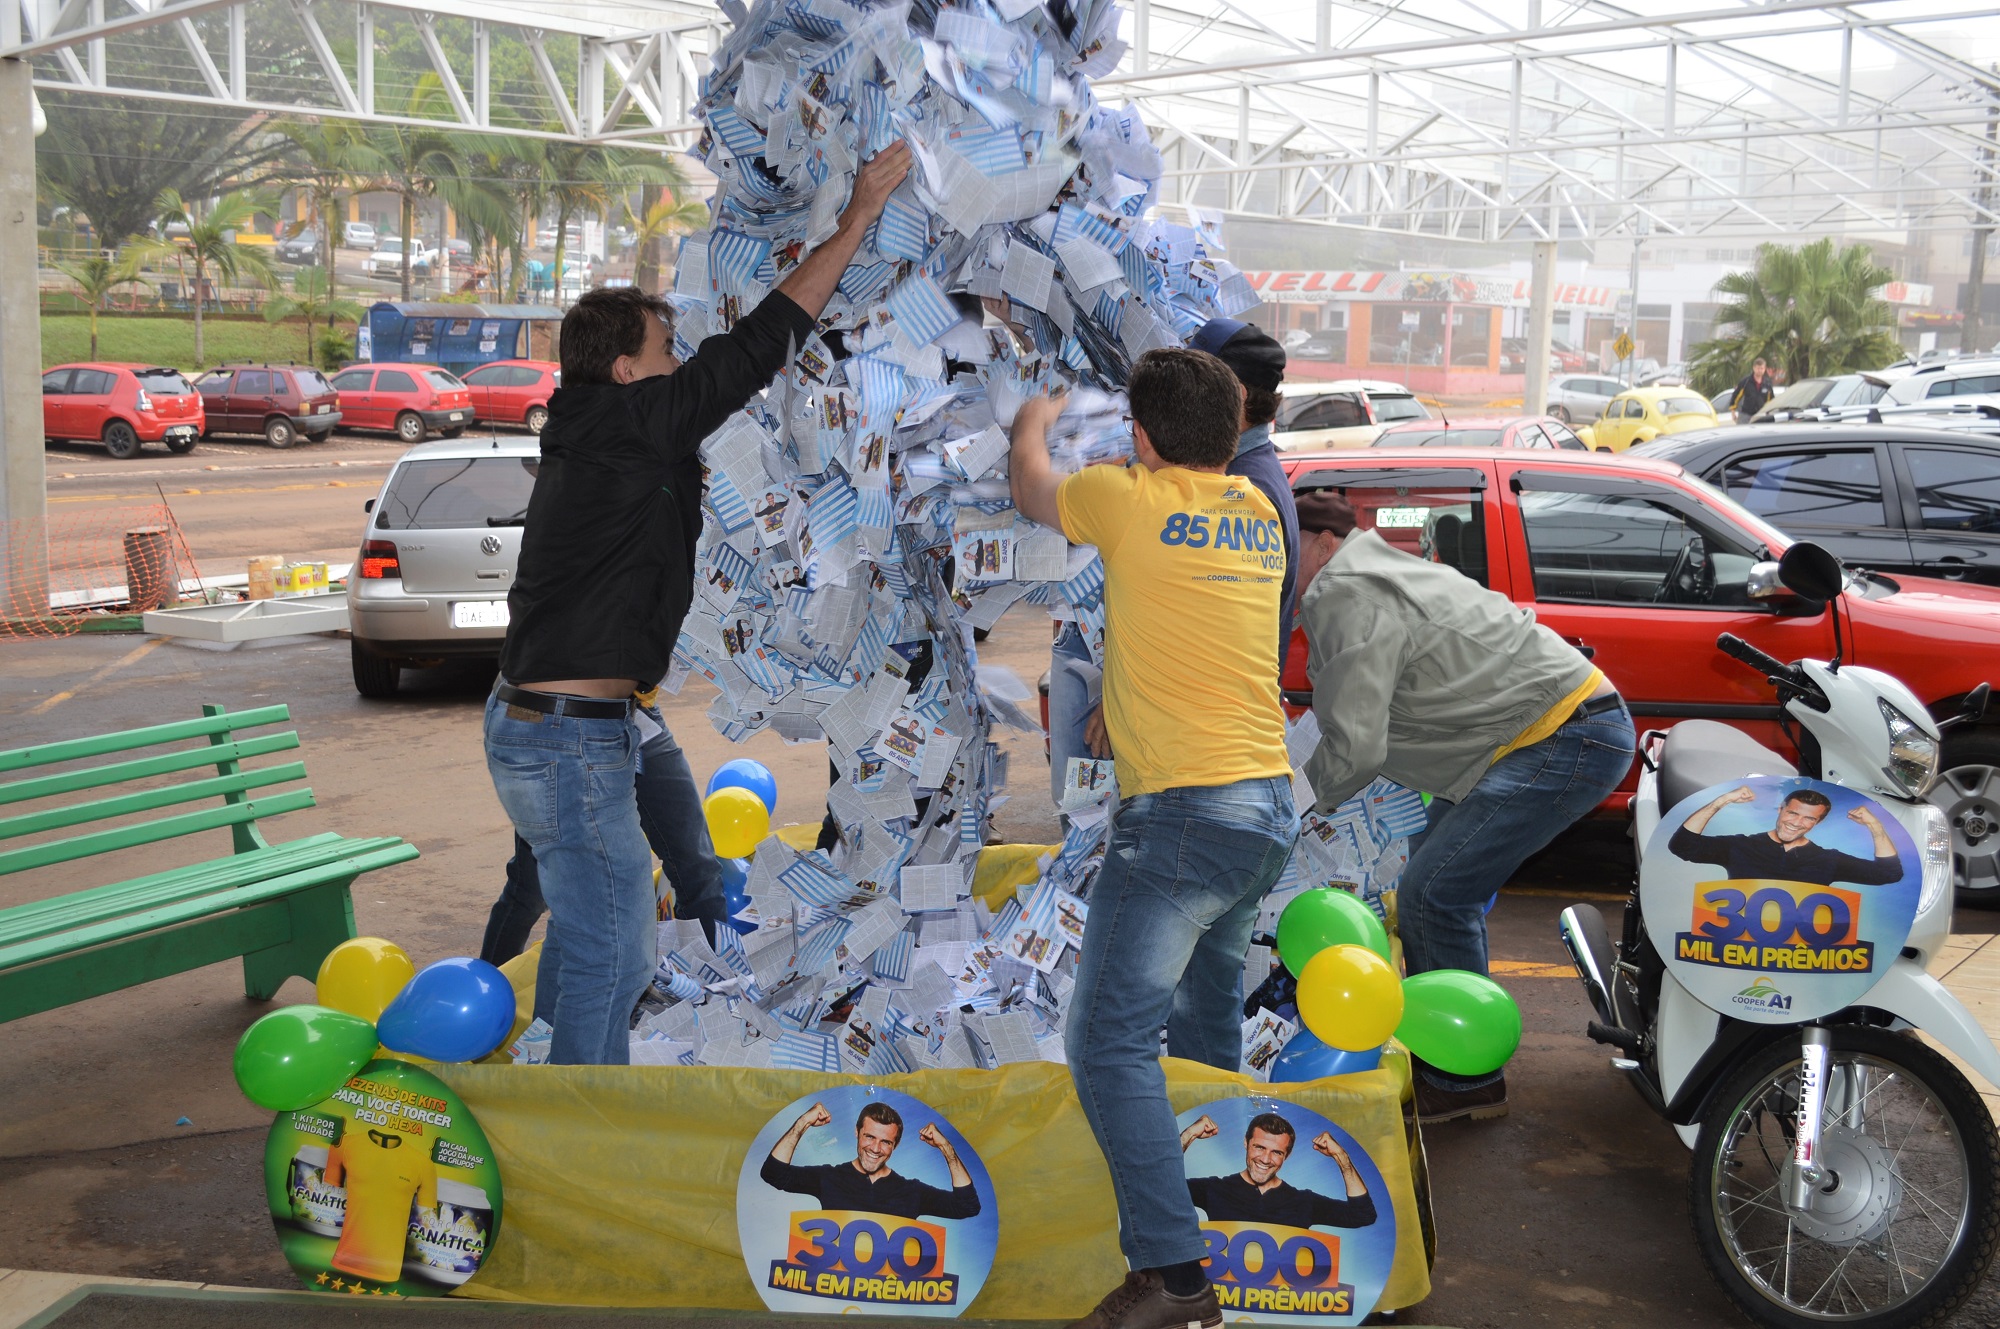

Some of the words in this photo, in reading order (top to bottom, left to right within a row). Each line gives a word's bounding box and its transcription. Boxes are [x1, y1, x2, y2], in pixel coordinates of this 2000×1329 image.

[1160, 512, 1210, 549] 85
[1213, 516, 1281, 552] ANOS
[1241, 553, 1259, 563] COM
[1260, 551, 1284, 571] VOCÊ
[1699, 887, 1850, 945] 300
[1679, 938, 1720, 963] MIL
[1723, 944, 1758, 967] EM
[1761, 942, 1869, 970] PRÊMIOS
[1732, 996, 1765, 1006] COOPER
[1767, 993, 1792, 1009] A1
[332, 1088, 365, 1108] PARA
[367, 1095, 402, 1115] VOCÊ
[402, 1105, 452, 1128] TORCER
[399, 1090, 416, 1106] DE
[417, 1093, 447, 1112] KITS
[291, 1112, 297, 1121] 1
[299, 1114, 315, 1125] KIT
[316, 1118, 335, 1130] POR
[294, 1121, 334, 1139] UNIDADE
[354, 1108, 388, 1126] PELO
[389, 1116, 423, 1136] HEXA
[438, 1147, 457, 1159] JOGO
[457, 1151, 467, 1160] DA
[467, 1154, 484, 1165] FASE
[439, 1140, 450, 1149] EM
[450, 1143, 468, 1153] CADA
[437, 1154, 447, 1163] DE
[447, 1156, 475, 1169] GRUPOS
[306, 1180, 348, 1195] TORCID
[422, 1215, 473, 1235] TORCIDA
[408, 1223, 483, 1254] FANÁTICA
[795, 1218, 938, 1279] 300
[1200, 1229, 1332, 1287] 300
[773, 1266, 812, 1292] MIL
[816, 1273, 850, 1296] EM
[853, 1273, 953, 1302] PRÊMIOS
[1244, 1283, 1350, 1313] PRÊMIOS
